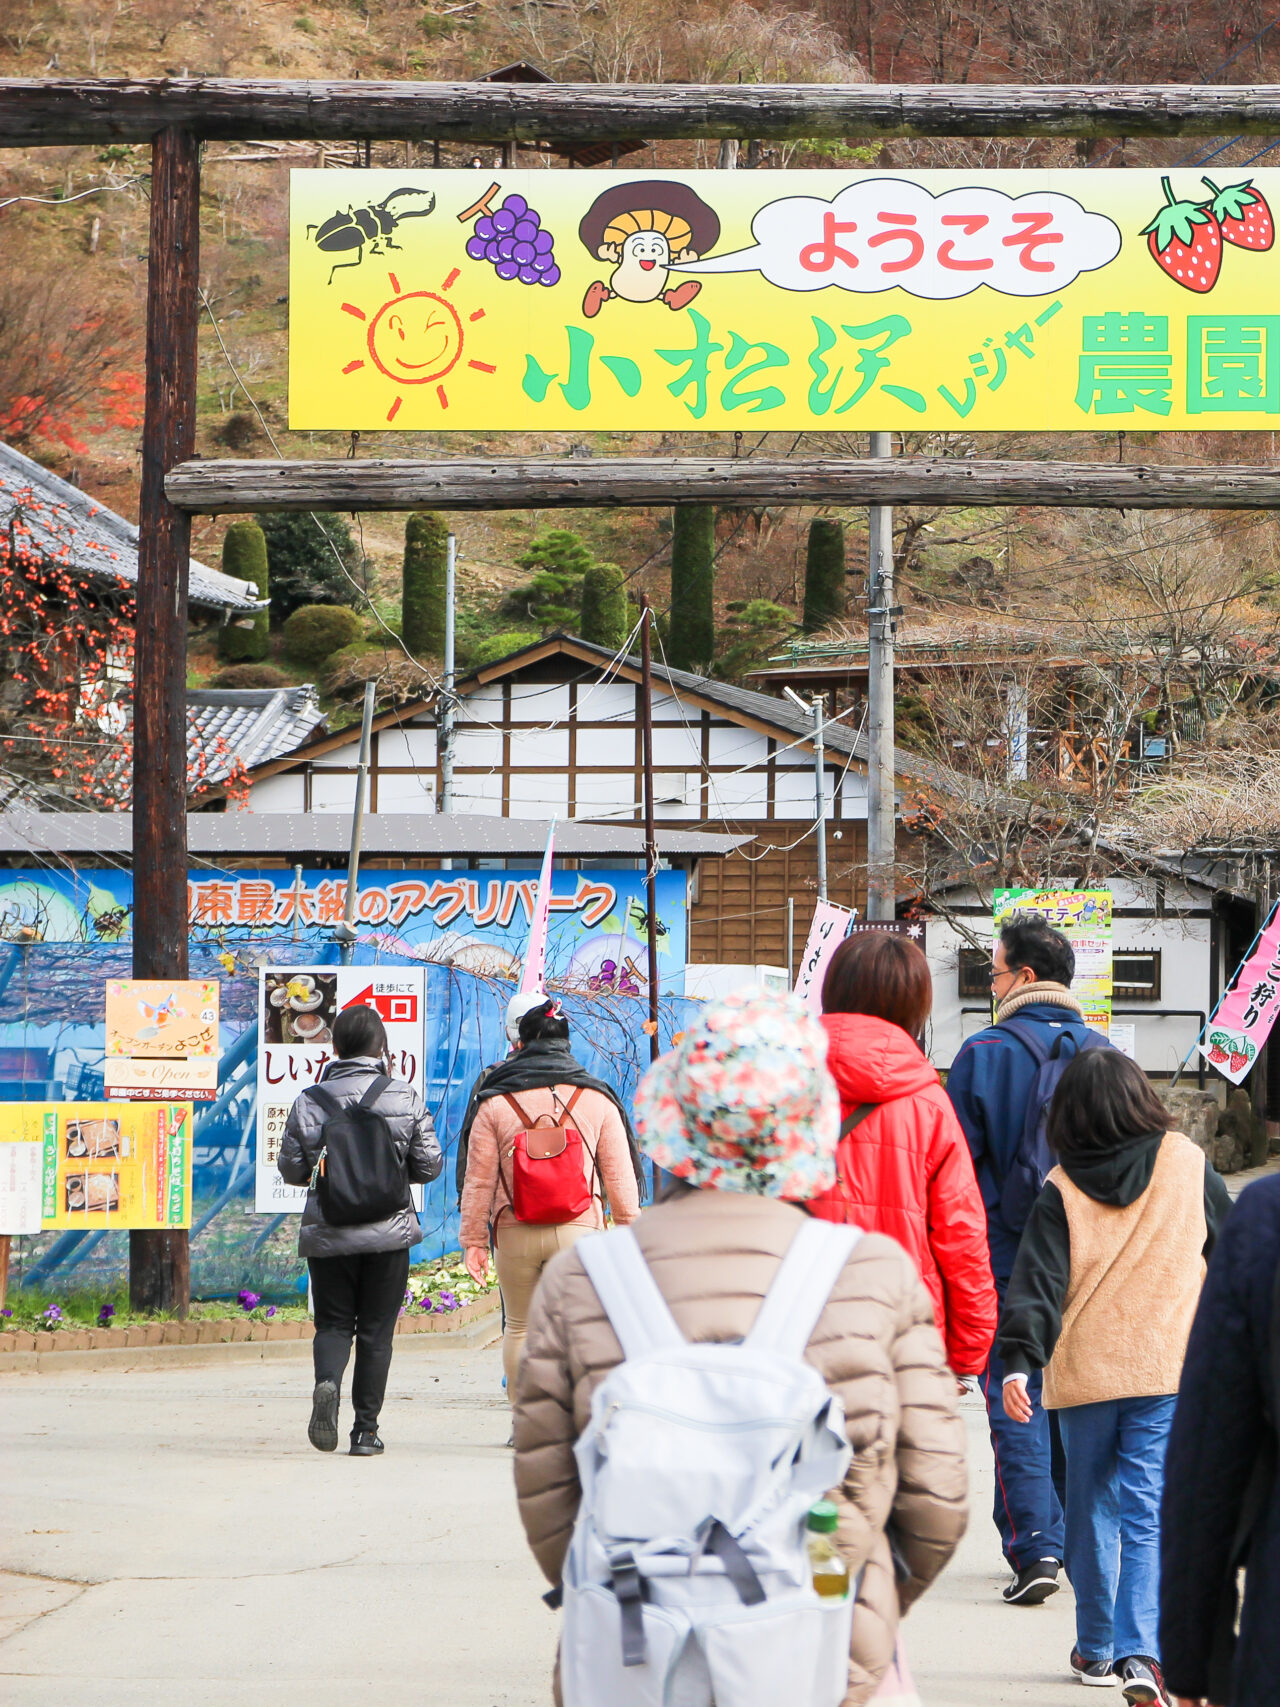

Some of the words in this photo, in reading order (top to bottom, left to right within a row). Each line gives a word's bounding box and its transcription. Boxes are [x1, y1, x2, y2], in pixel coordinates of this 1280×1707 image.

[798, 210, 1064, 273] ようこそ
[188, 879, 613, 925] 東最大級のアグリパーク
[375, 983, 415, 993] 徒歩にて
[201, 1011, 214, 1021] 43
[151, 1064, 191, 1084] Open
